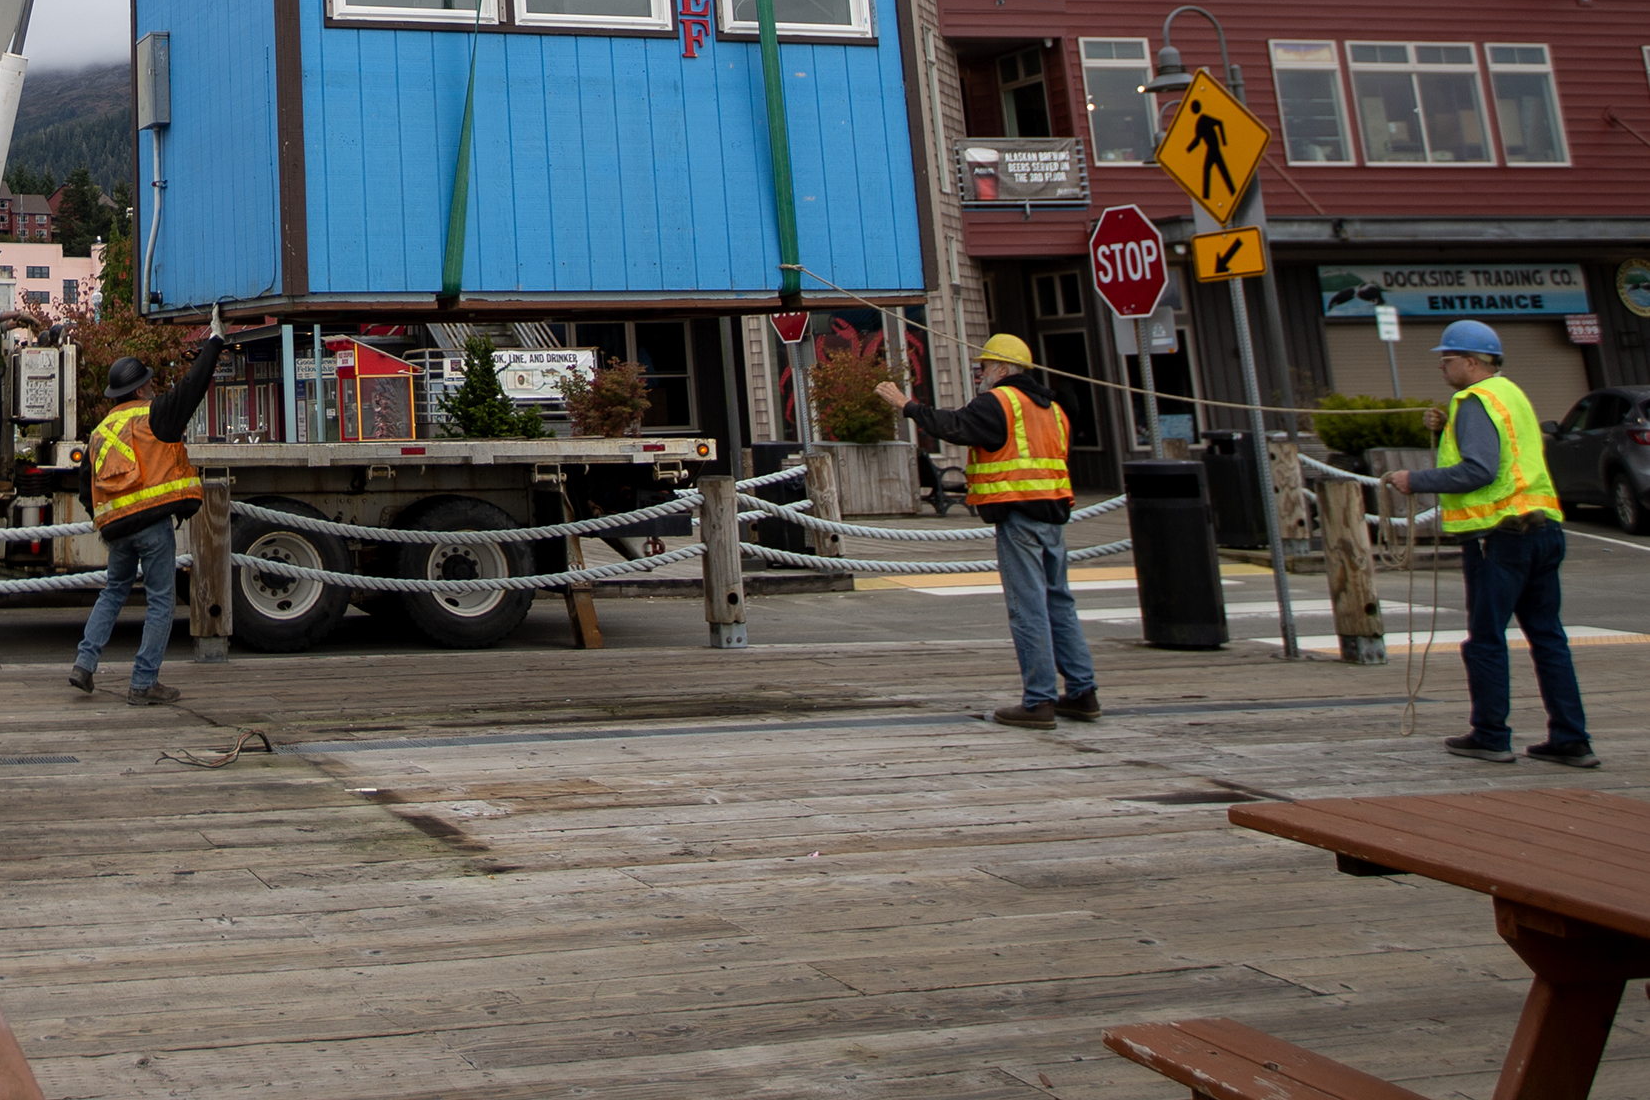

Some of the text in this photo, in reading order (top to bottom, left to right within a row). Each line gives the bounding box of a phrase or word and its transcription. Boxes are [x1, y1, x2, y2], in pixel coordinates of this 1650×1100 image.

[1005, 150, 1070, 163] ALASKAN BREWING
[1007, 161, 1070, 173] BEERS SERVED ON
[1014, 171, 1067, 183] THE 3RD FLOOR
[1097, 239, 1158, 285] STOP
[1383, 269, 1578, 288] DOCKSIDE TRADING CO.
[1428, 294, 1544, 311] ENTRANCE
[529, 354, 544, 363] AND
[547, 353, 577, 363] DRINKER
